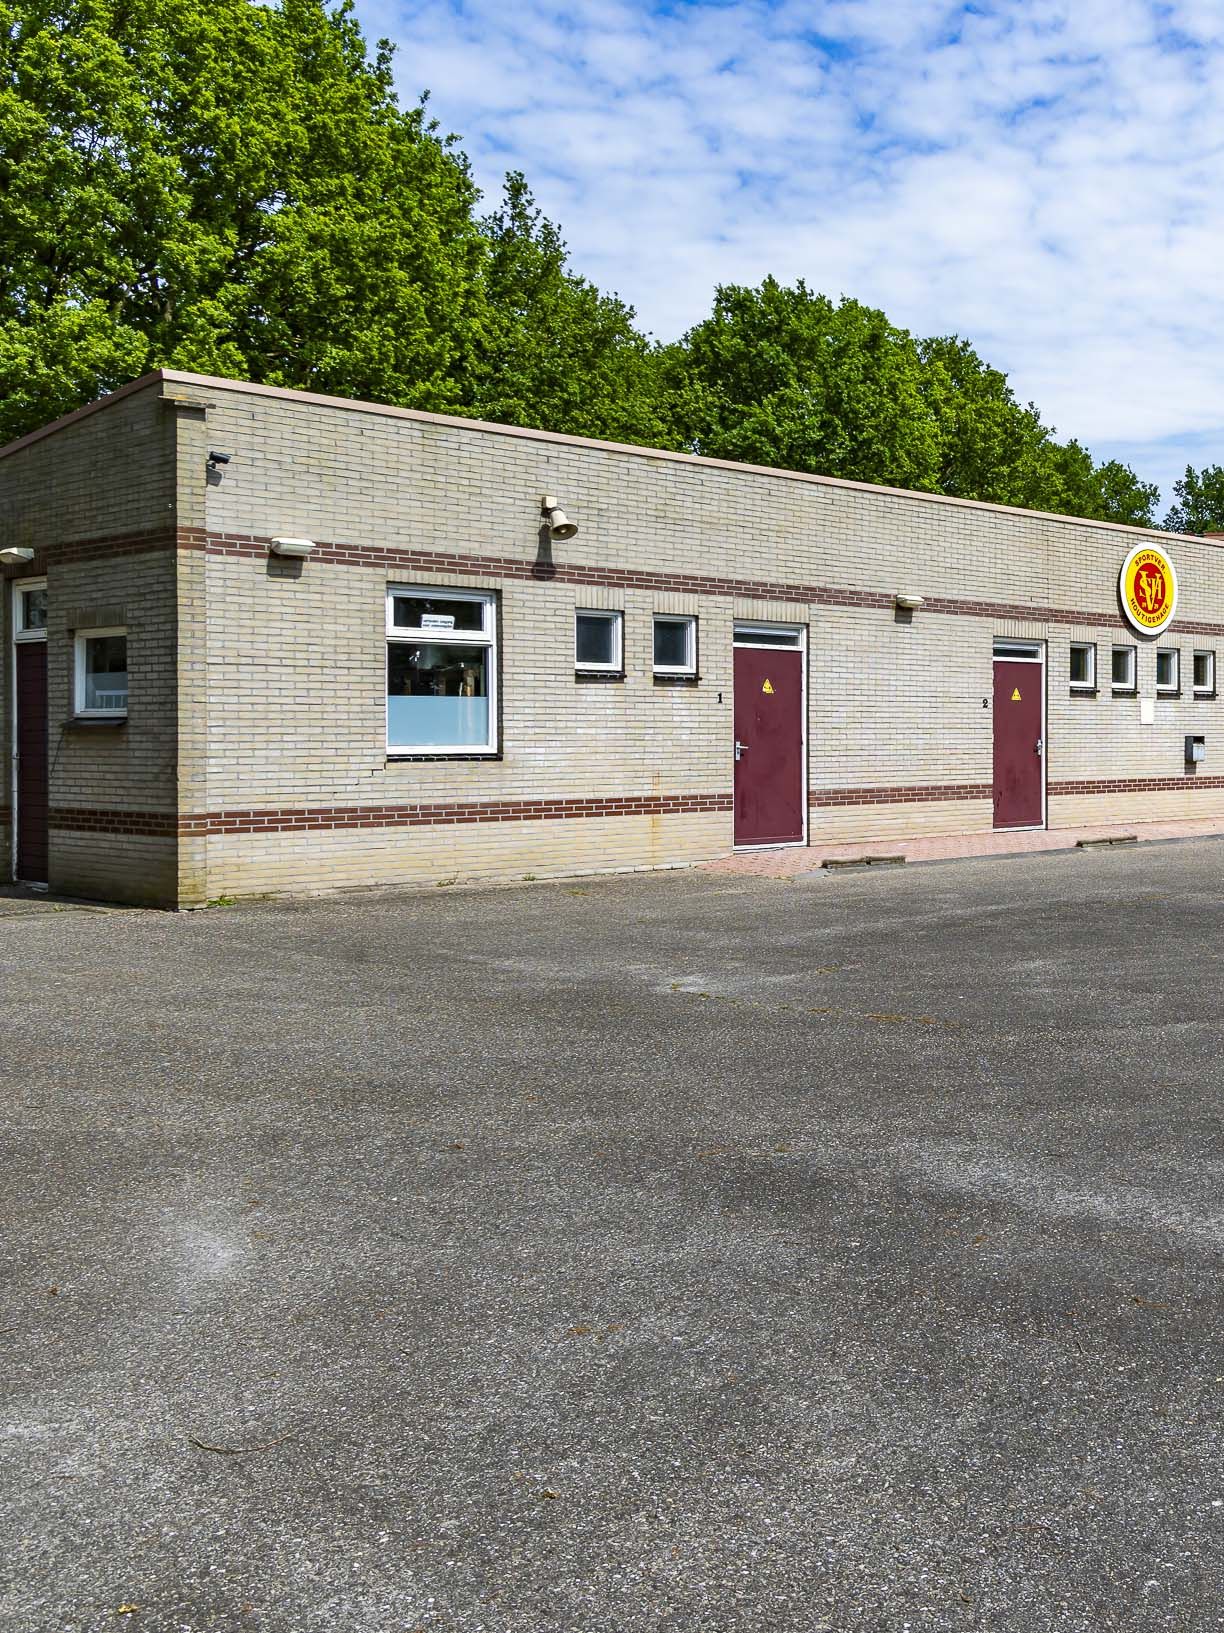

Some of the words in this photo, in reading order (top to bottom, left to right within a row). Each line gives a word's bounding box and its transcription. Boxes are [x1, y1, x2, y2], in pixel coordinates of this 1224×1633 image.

[1130, 598, 1169, 623] HOUTIGEHAGE
[717, 692, 723, 704] 1
[982, 698, 989, 709] 2
